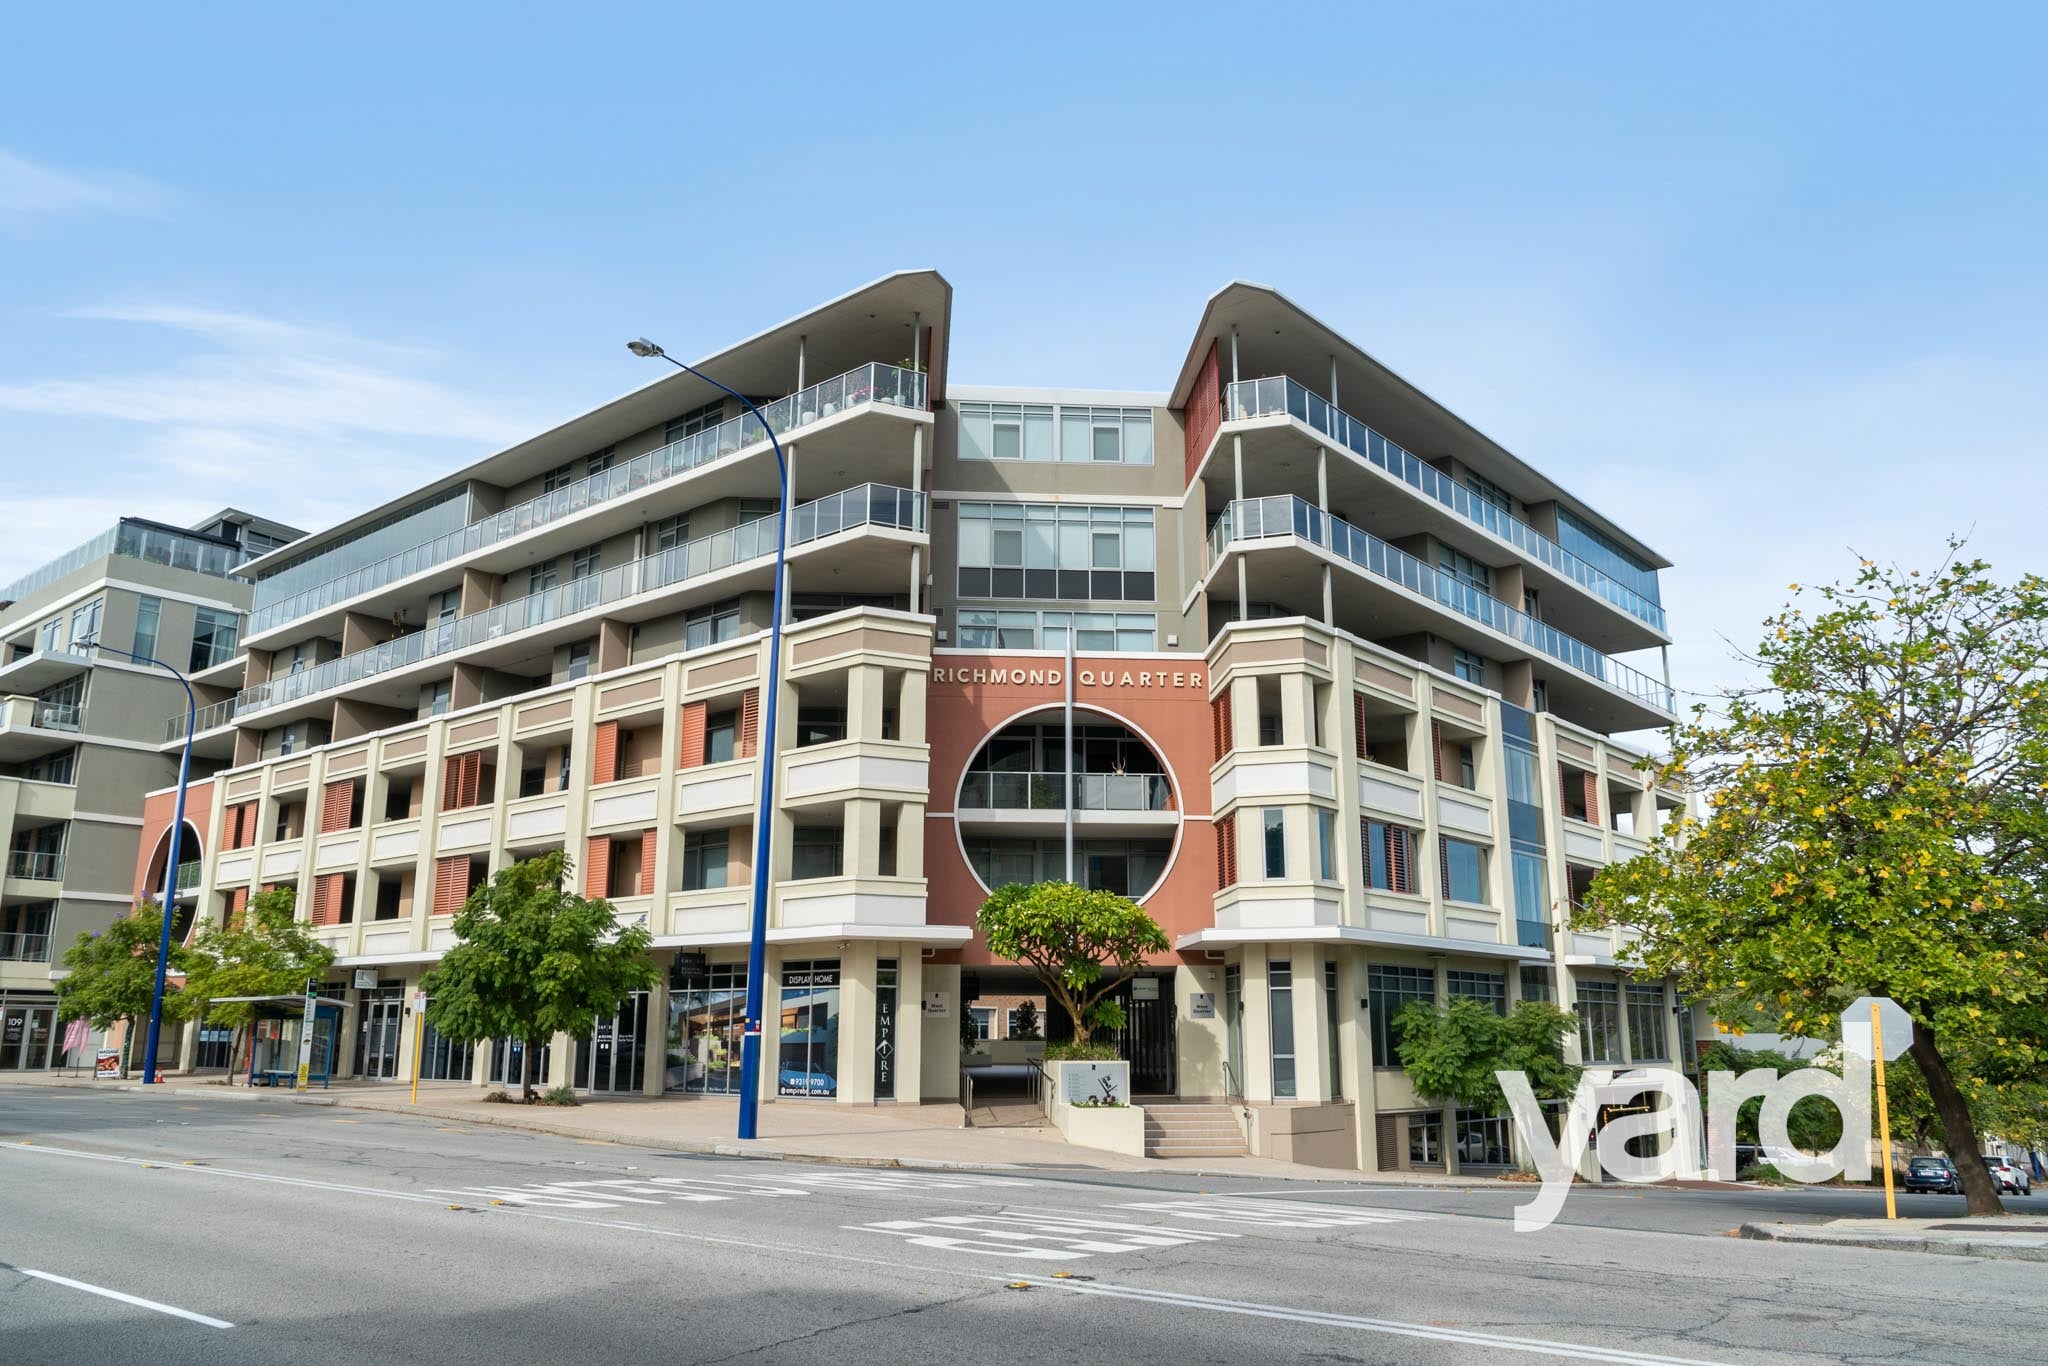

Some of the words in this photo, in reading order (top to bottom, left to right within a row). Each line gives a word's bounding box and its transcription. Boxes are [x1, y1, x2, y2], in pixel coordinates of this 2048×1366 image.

[933, 667, 1062, 685] RICHMOND
[1079, 670, 1204, 688] QUARTER
[789, 975, 811, 984] DISPLAY
[814, 974, 833, 983] HOME
[8, 1018, 23, 1026] 109
[810, 1078, 825, 1086] 9700
